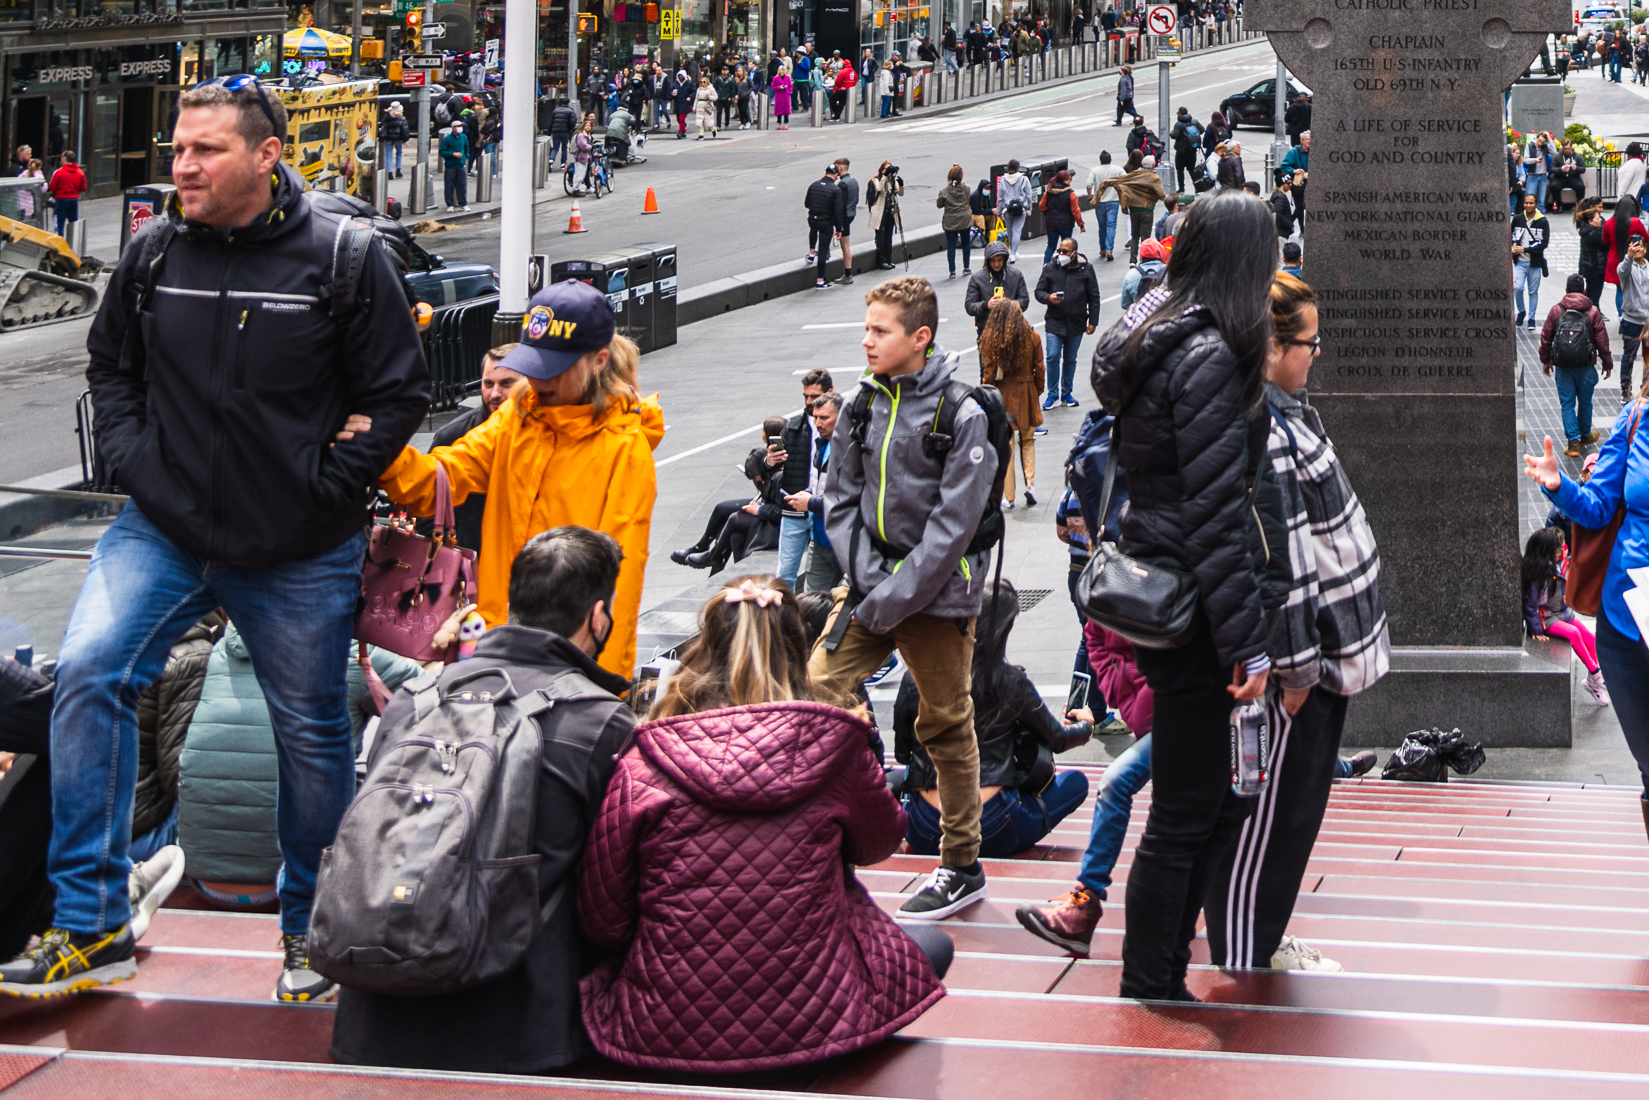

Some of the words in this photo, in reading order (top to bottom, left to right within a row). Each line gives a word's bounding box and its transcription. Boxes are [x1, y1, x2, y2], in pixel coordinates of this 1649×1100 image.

[405, 2, 413, 10] 46
[663, 11, 672, 35] ATM
[1369, 36, 1445, 48] CHAPLAIN
[487, 48, 494, 63] 7
[120, 59, 172, 77] EXPRESS
[38, 65, 94, 84] EXPRESS
[1353, 120, 1385, 132] LIFE
[1391, 120, 1411, 132] OF
[1418, 120, 1481, 132] SERVICE
[1394, 137, 1419, 147] FOR
[1328, 151, 1366, 164] GOD
[1371, 152, 1404, 164] AND
[1410, 151, 1486, 164] COUNTRY
[1325, 192, 1378, 203] SPANISH
[1382, 192, 1452, 203] AMERICAN
[1458, 192, 1488, 203] WAR
[1341, 211, 1378, 222] YORK
[1384, 211, 1452, 222] NATIONAL
[1457, 211, 1506, 222] GUARD
[1344, 230, 1408, 241] MEXICAN
[1412, 230, 1467, 241] BORDER
[1360, 249, 1411, 260] WORLD
[1420, 249, 1452, 260] WAR
[1407, 289, 1459, 300] SERVICE
[1465, 289, 1507, 300] CROSS
[262, 301, 311, 311] BELOWZERO
[1407, 308, 1460, 319] SERVICE
[1465, 308, 1510, 319] MEDAL
[1407, 327, 1459, 339] SERVICE
[1465, 327, 1507, 339] CROSS
